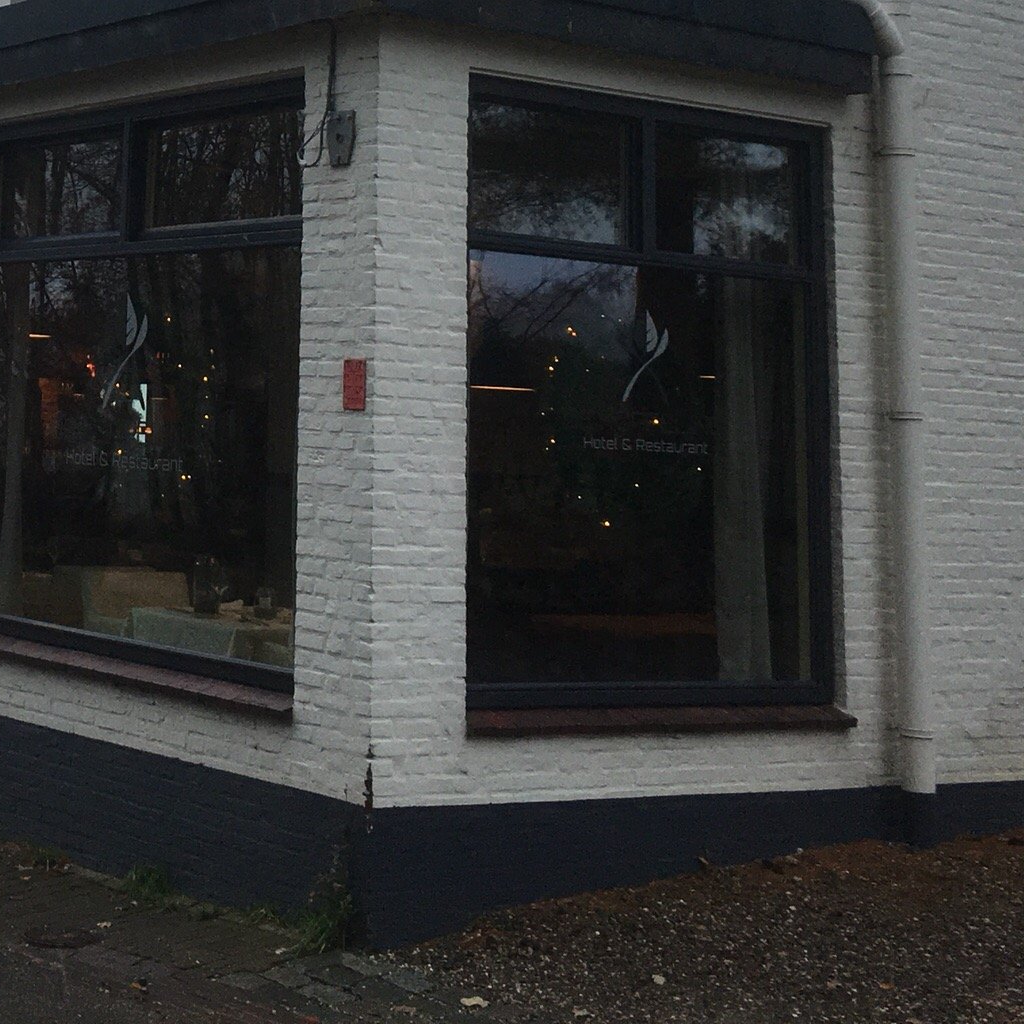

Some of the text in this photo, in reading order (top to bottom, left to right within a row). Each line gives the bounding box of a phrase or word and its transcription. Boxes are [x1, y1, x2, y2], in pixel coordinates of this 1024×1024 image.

[583, 436, 708, 454] Hotel & Restaurant
[65, 446, 96, 466] Hotel
[112, 452, 183, 472] Restaurant
